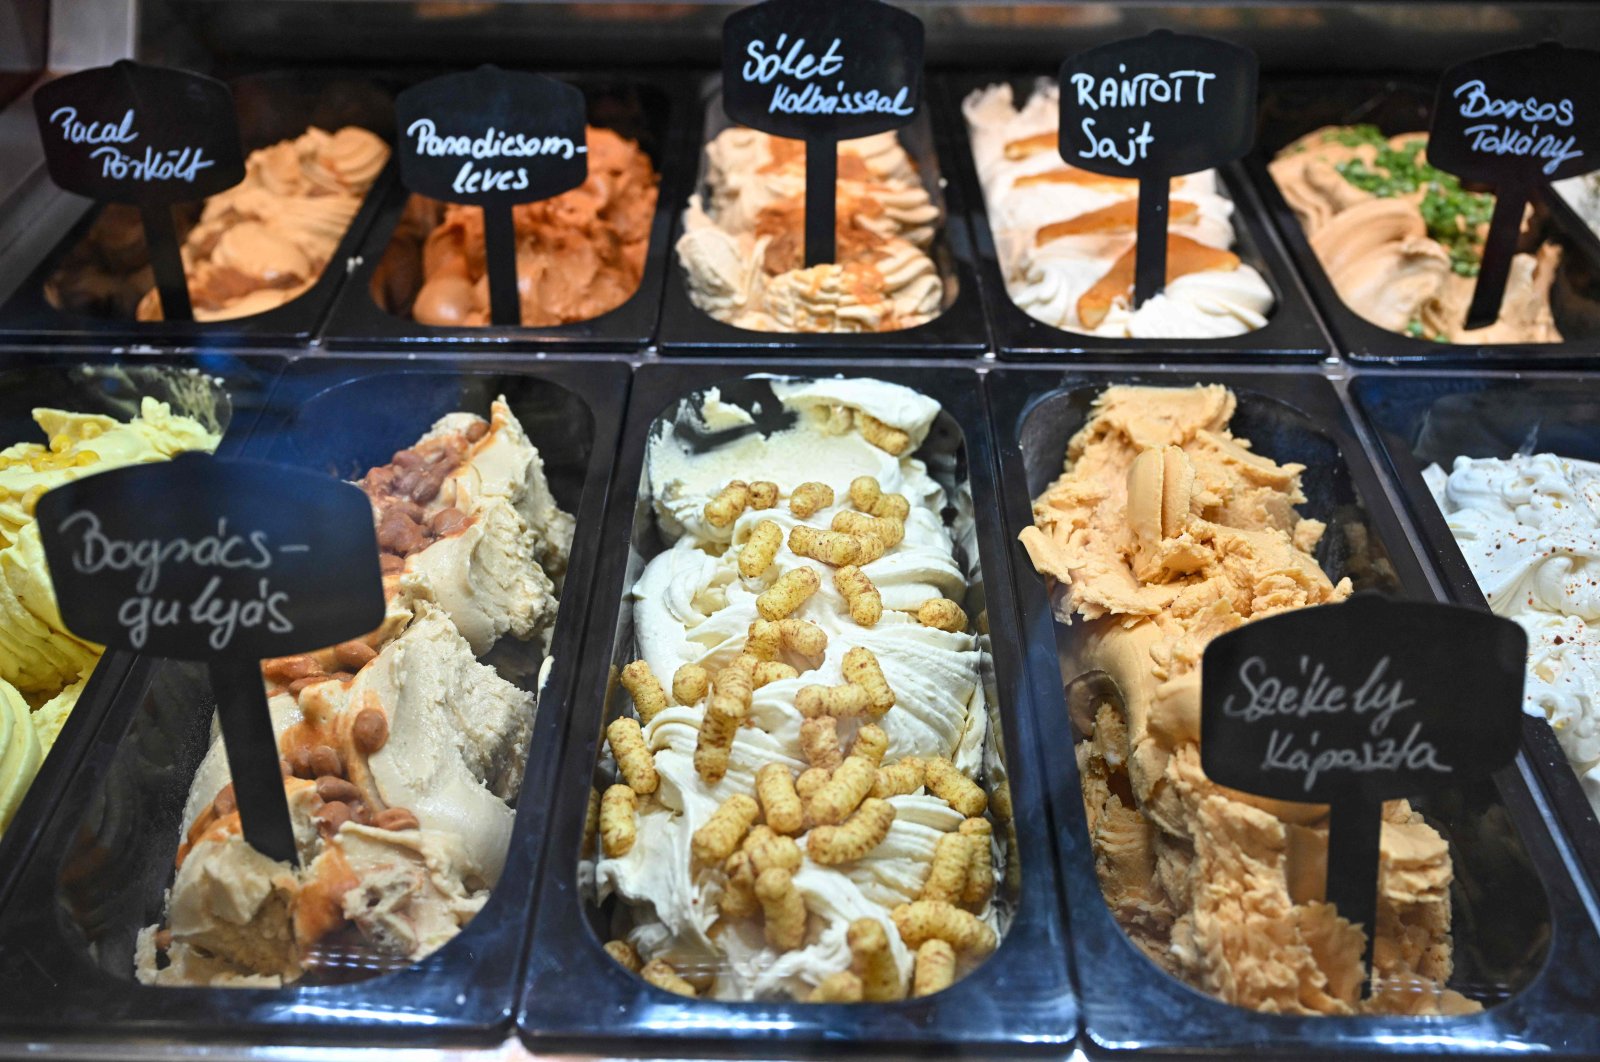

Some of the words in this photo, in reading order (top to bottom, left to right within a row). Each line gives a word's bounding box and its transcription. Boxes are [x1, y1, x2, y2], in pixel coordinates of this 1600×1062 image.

[742, 33, 844, 84] Sólet
[49, 106, 140, 144] Pacal
[1453, 79, 1575, 126] Borsos
[1078, 117, 1155, 166] Sajt
[452, 161, 530, 194] leves
